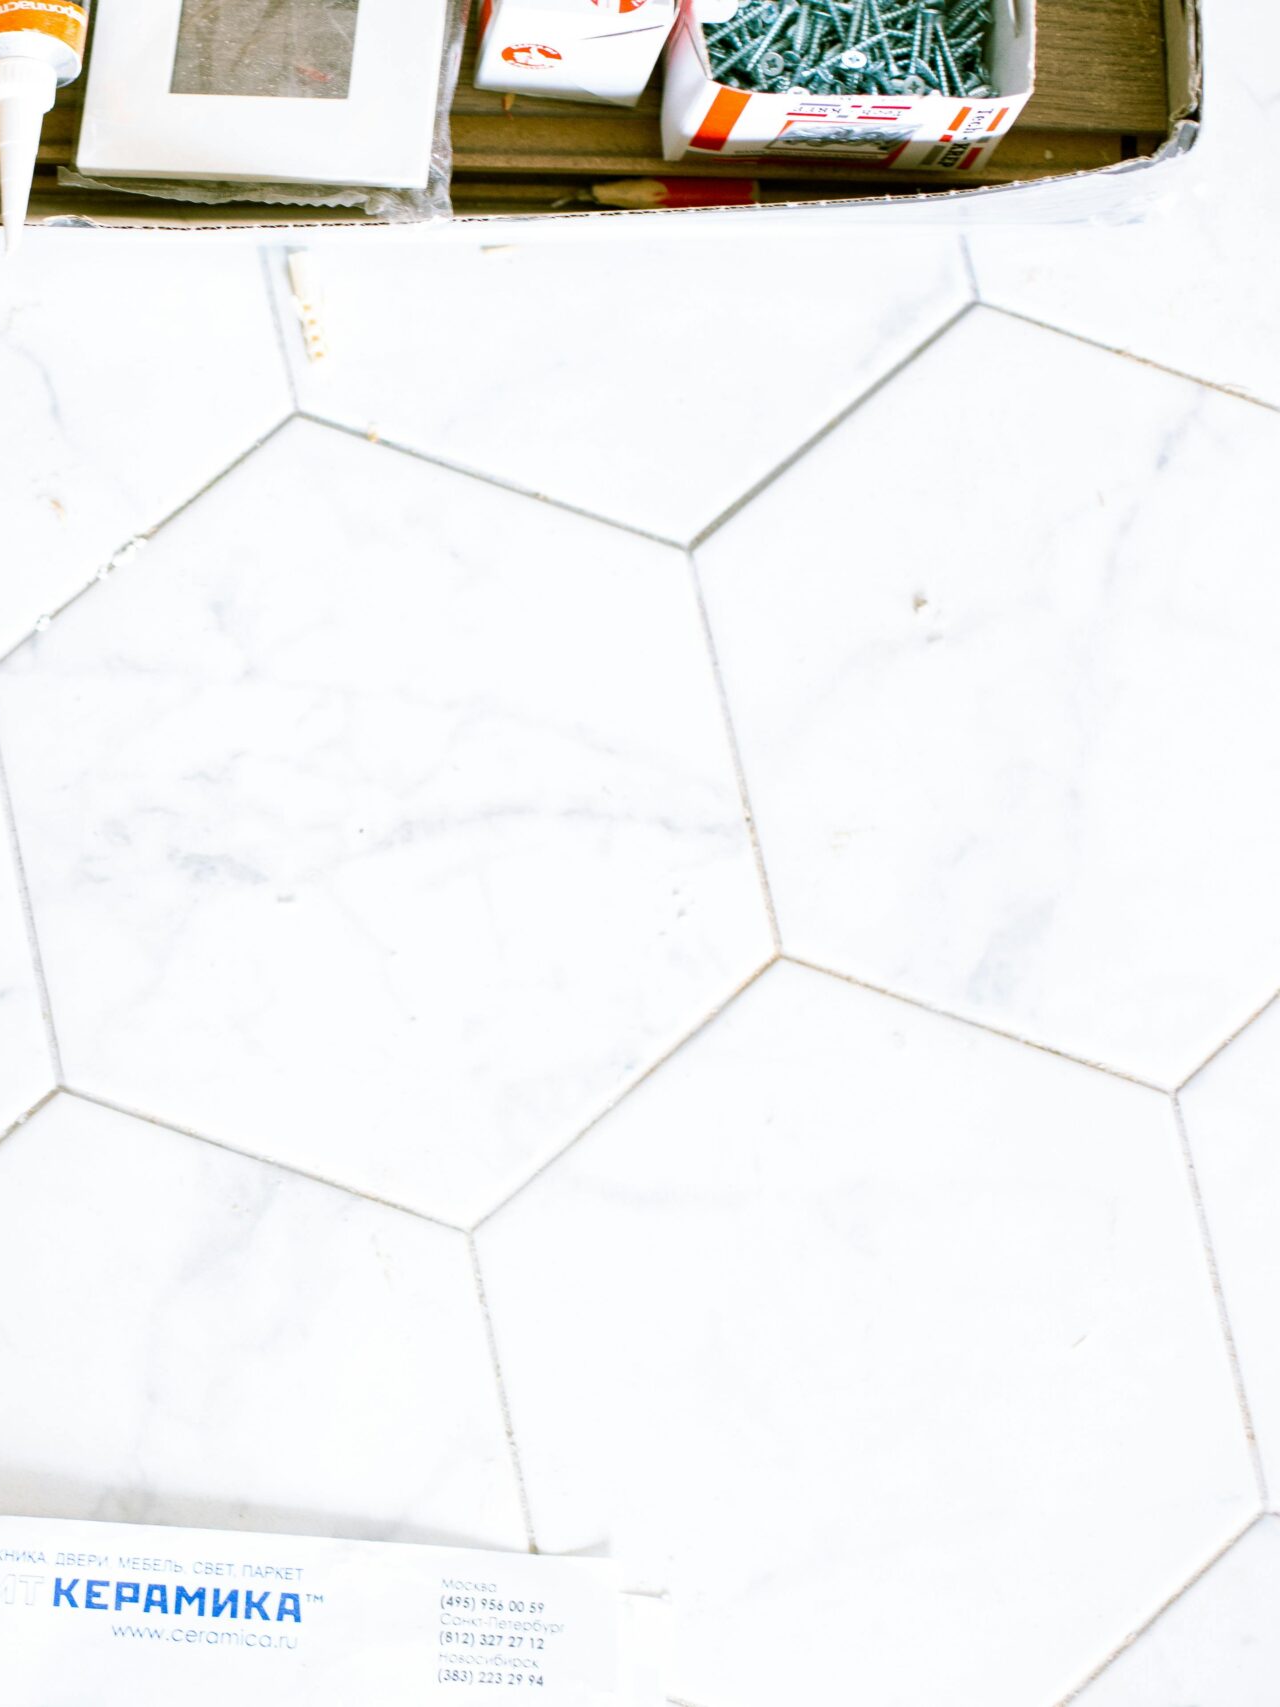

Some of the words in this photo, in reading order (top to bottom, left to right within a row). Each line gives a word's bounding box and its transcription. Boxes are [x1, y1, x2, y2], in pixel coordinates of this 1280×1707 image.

[242, 1563, 304, 1581] ПАРКЕТ
[441, 1578, 497, 1594] Москва
[439, 1594, 476, 1612] (495)
[480, 1598, 504, 1611] 956
[509, 1600, 525, 1613] 00
[529, 1602, 545, 1614] 59
[439, 1612, 565, 1635] Санкт-Петербург
[111, 1624, 298, 1650] www.ceramica.ru
[439, 1630, 475, 1647] (812)
[479, 1633, 503, 1647] 327
[508, 1635, 523, 1648] 27
[529, 1637, 545, 1650] 12
[437, 1668, 474, 1686] (383)
[478, 1671, 503, 1685] 223
[508, 1673, 523, 1686] 29
[528, 1674, 544, 1687] 94
